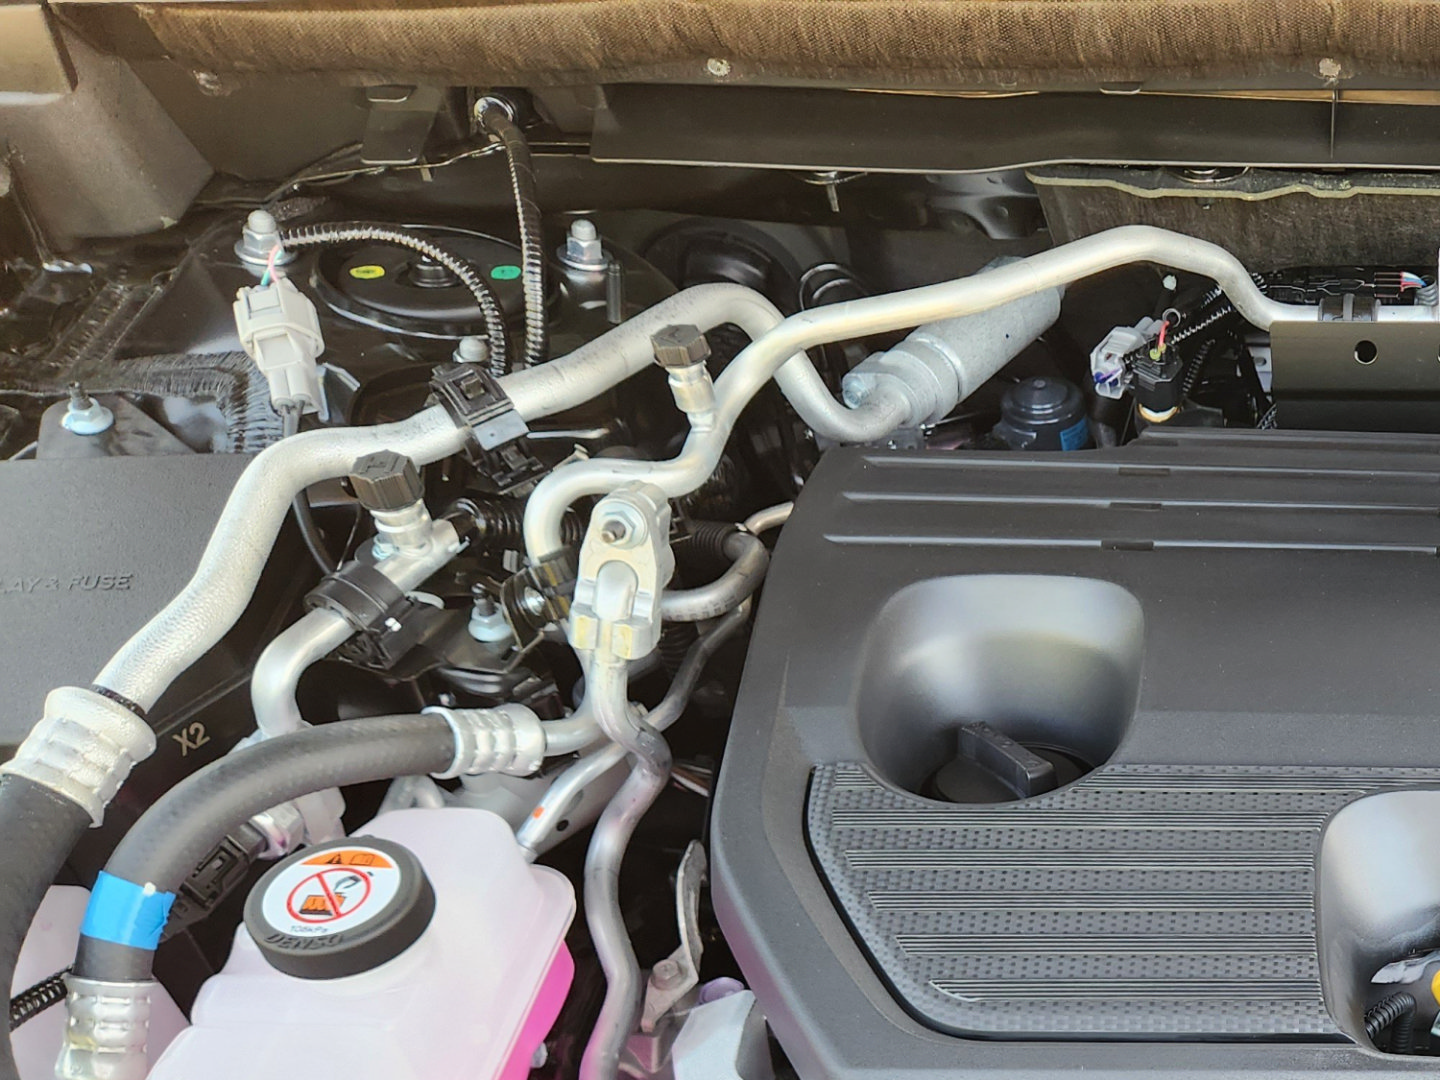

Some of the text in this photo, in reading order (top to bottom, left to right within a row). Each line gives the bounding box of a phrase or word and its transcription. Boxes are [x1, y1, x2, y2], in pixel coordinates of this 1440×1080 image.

[68, 573, 134, 591] FUSE
[172, 721, 211, 757] X2
[264, 932, 344, 950] DENSO
